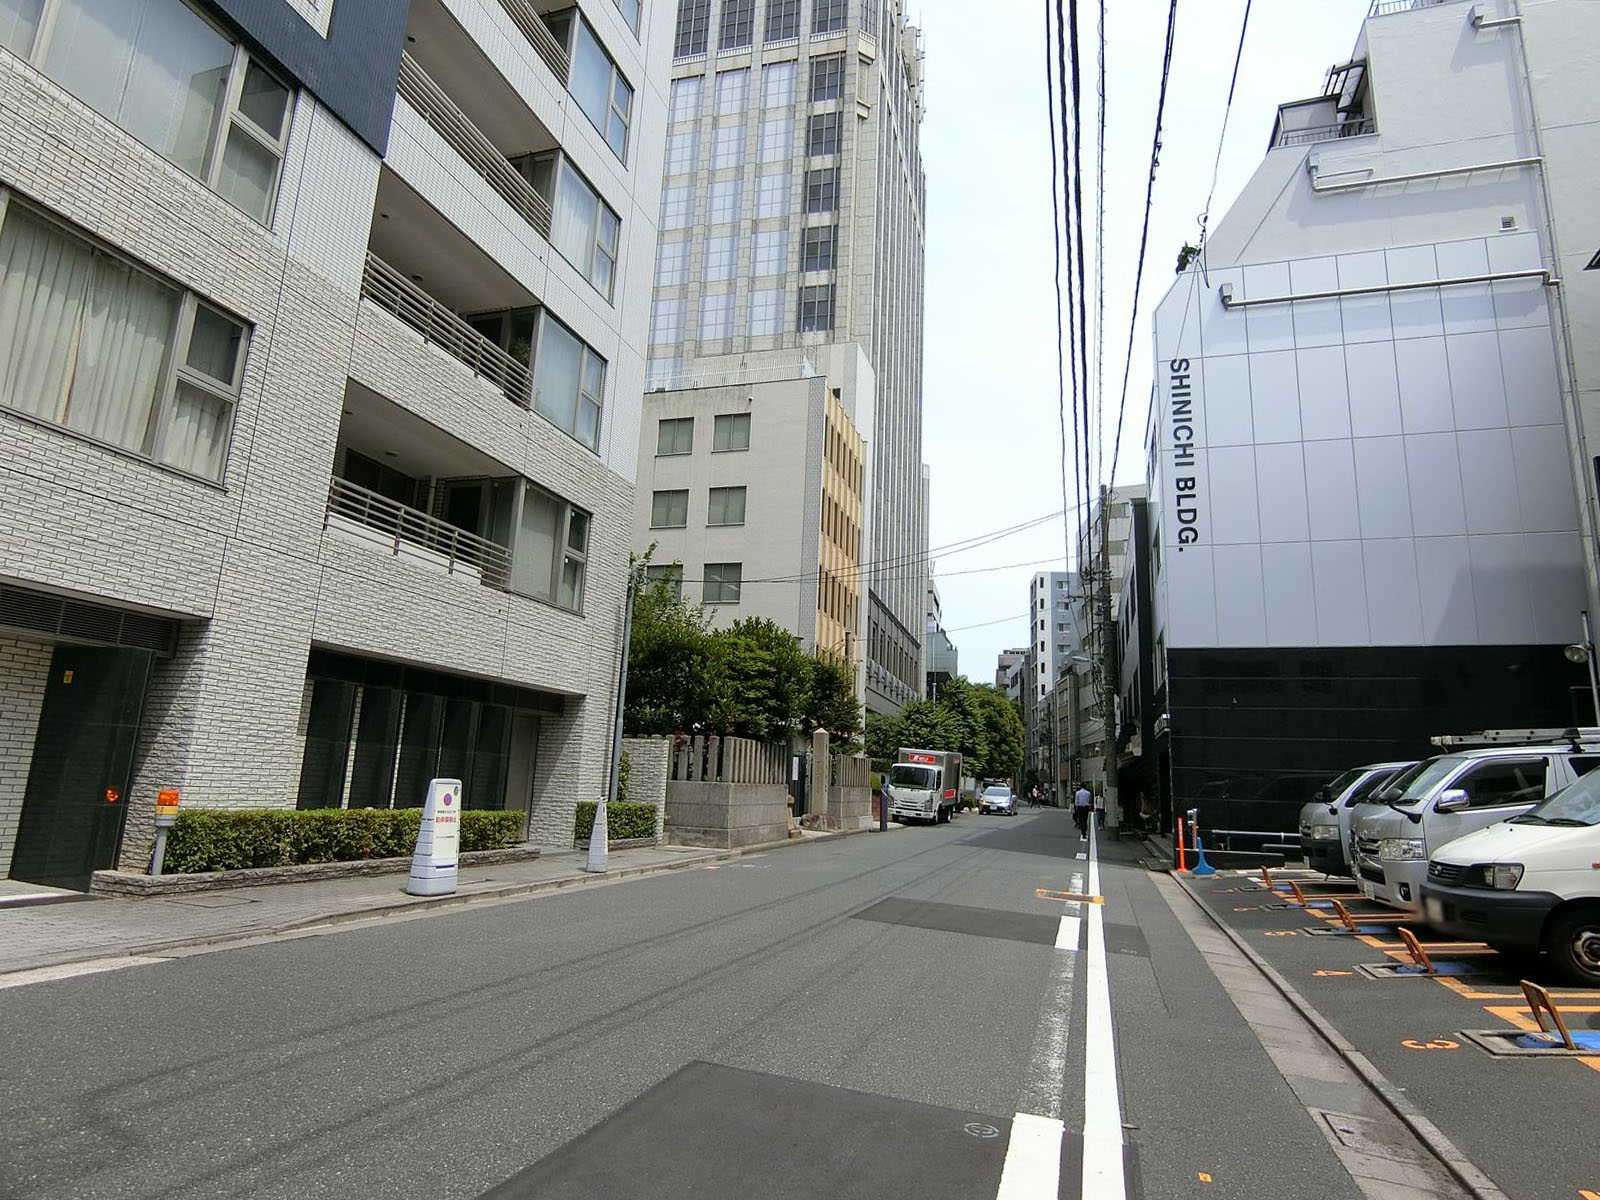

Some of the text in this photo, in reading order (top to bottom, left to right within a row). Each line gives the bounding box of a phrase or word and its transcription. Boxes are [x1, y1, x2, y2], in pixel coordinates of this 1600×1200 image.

[1170, 358, 1199, 552] SHINICHI BLDG.
[1401, 1039, 1460, 1050] 3
